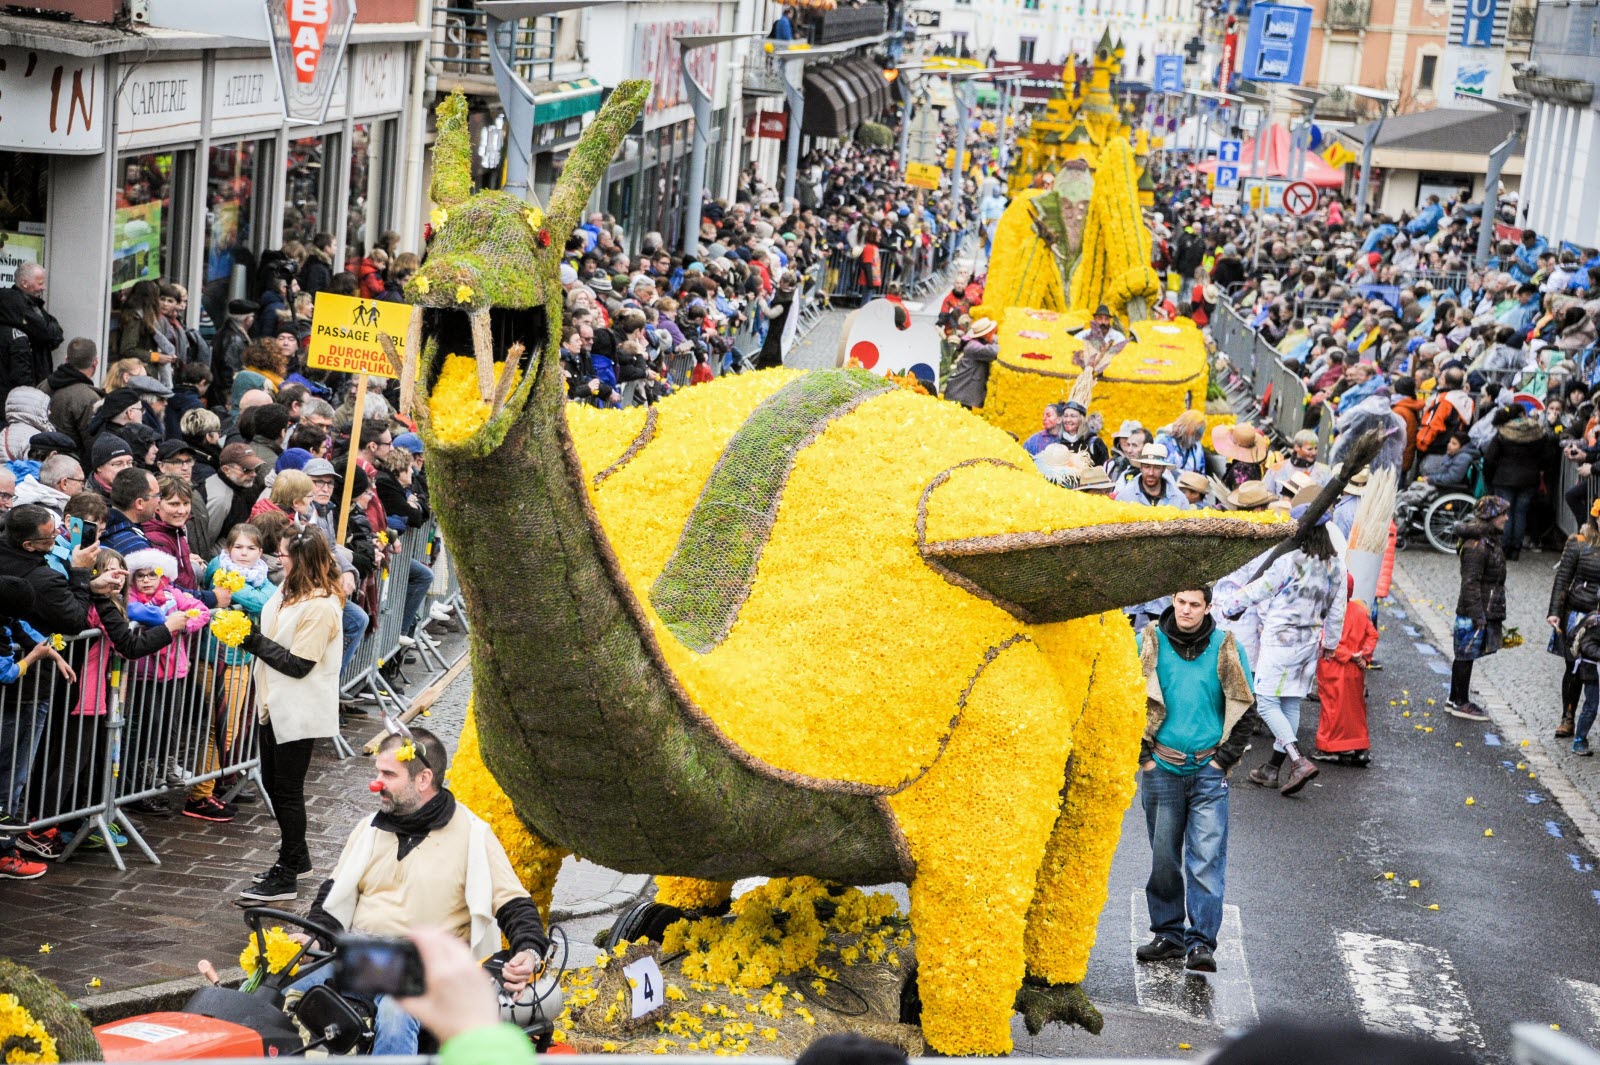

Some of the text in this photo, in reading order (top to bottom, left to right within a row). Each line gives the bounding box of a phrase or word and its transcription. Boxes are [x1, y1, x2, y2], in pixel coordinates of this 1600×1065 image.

[131, 79, 188, 116] CARTERIE
[223, 74, 264, 107] ATELIER
[1220, 168, 1233, 185] P
[318, 325, 369, 341] PASSAGE
[330, 345, 402, 362] DURCHGA
[318, 355, 396, 374] DES PUBLIKU
[645, 973, 653, 1002] 4
